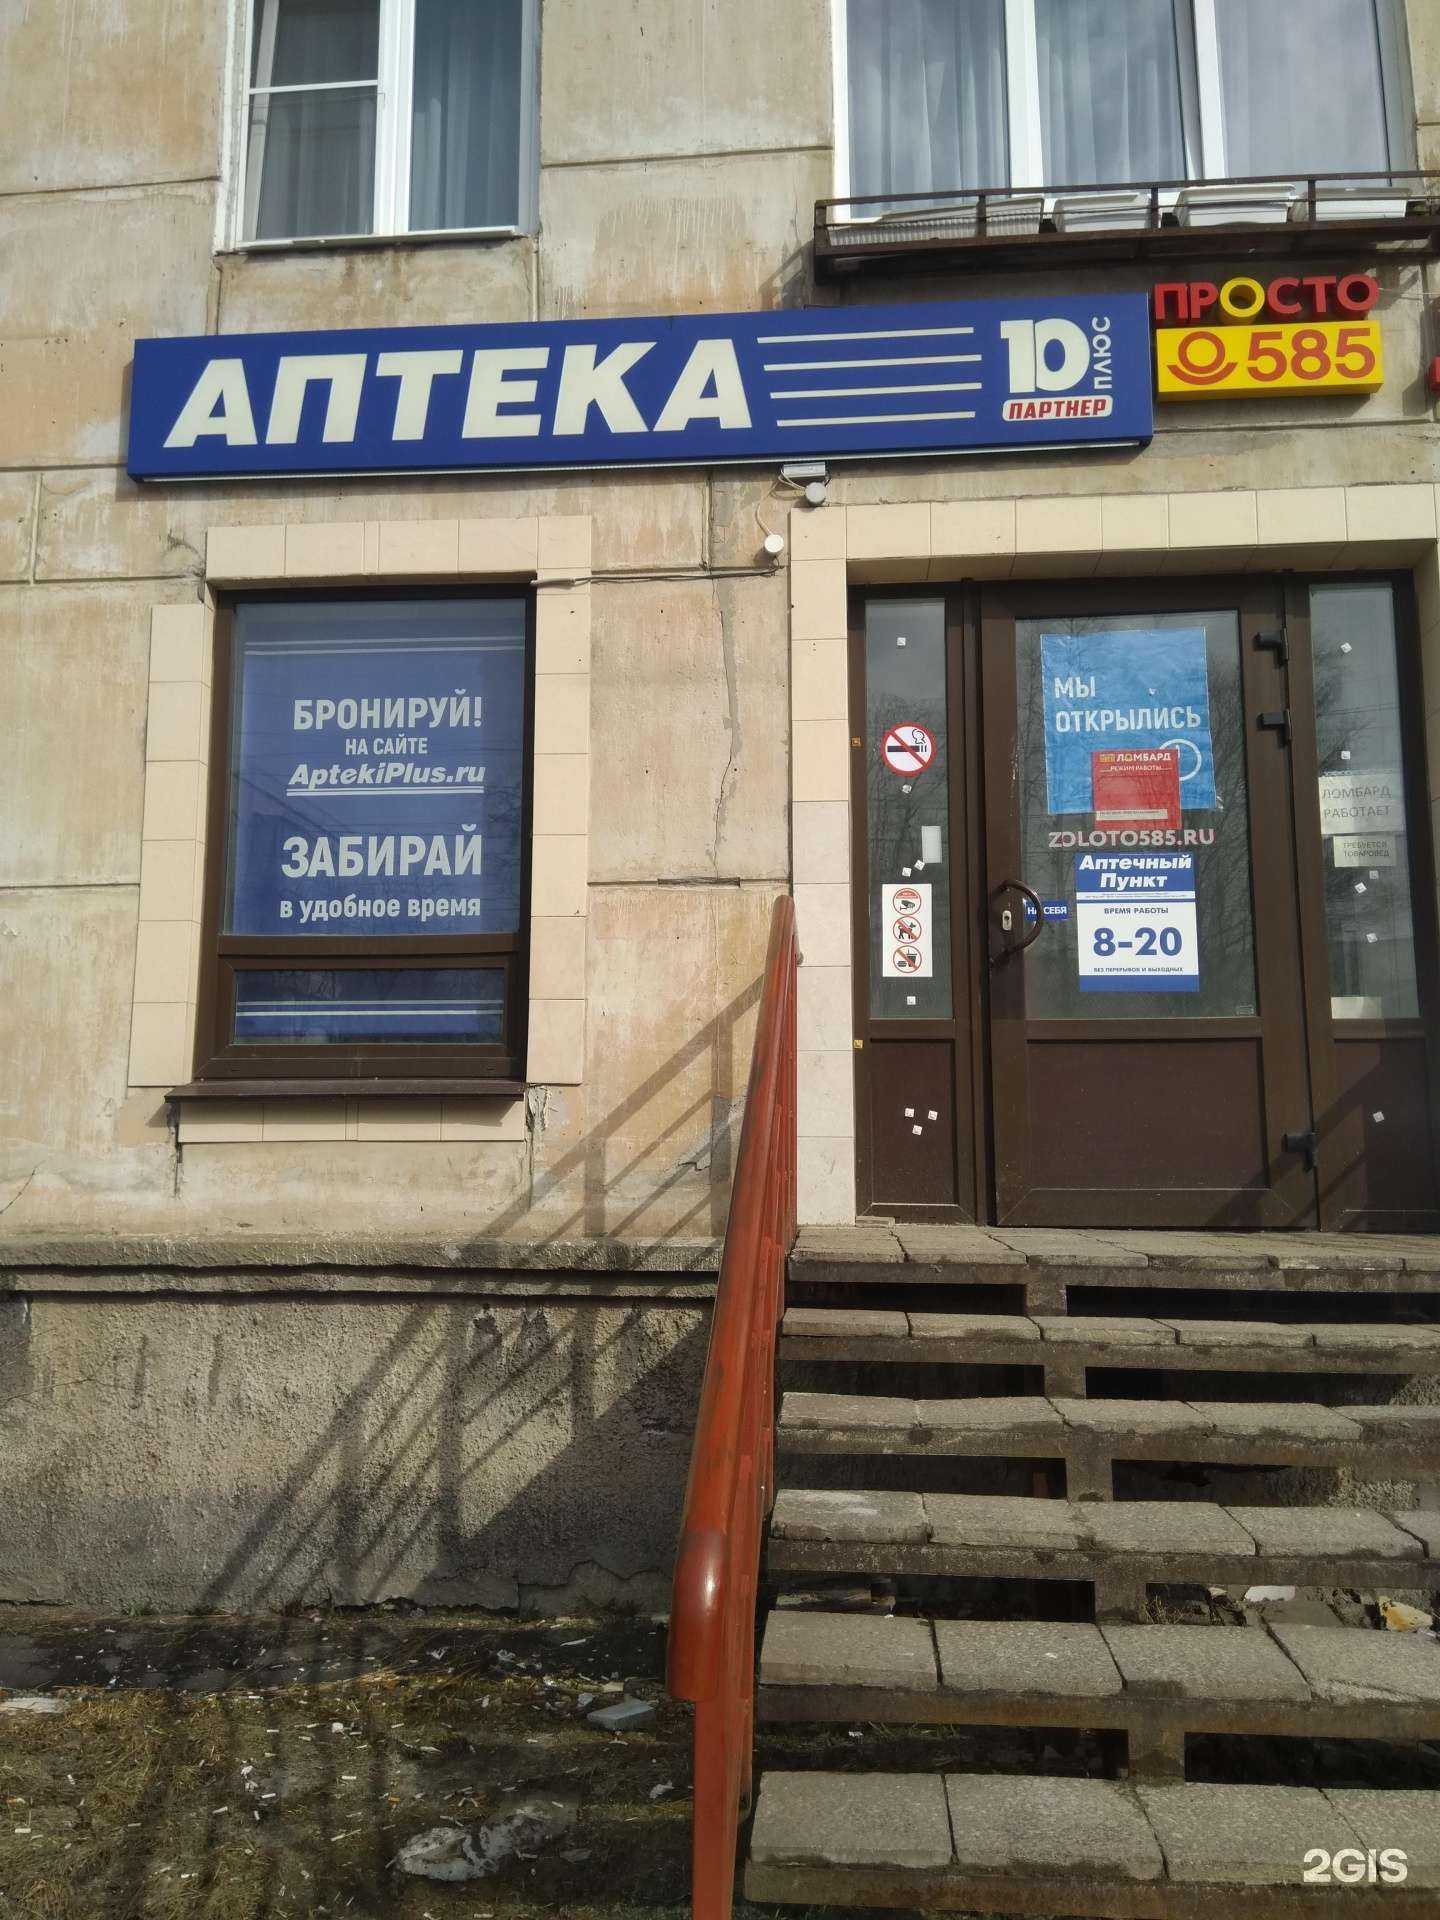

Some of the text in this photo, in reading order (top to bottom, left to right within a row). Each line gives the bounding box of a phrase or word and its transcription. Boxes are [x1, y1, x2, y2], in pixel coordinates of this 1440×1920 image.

[1154, 273, 1380, 321] ПРОСТО
[1000, 318, 1090, 393] 10
[1091, 316, 1113, 390] ПЛЮС
[1247, 327, 1376, 383] 585
[162, 338, 753, 448] АПТЕКА
[1008, 398, 1107, 420] ПАРТНЕР
[1054, 676, 1095, 698] МЫ
[293, 688, 483, 731] БРОНИРУЙ!
[1055, 705, 1201, 733] ОТКРЫЛИСЬ
[345, 733, 428, 755] НА САЙТЕ
[1116, 752, 1172, 762] ЛОМБАРД
[288, 762, 486, 790] AptekiPlus.ru
[1321, 785, 1392, 799] ЛОМБАРД
[1323, 805, 1391, 818] РАБОТАЕТ
[281, 823, 482, 879] ЗАБИРАЙ
[1079, 855, 1192, 870] Аптечный
[1100, 873, 1168, 891] Пункт
[279, 892, 481, 923] в удобное время
[1043, 906, 1067, 915] СЕБЯ
[1093, 926, 1183, 957] 8-20
